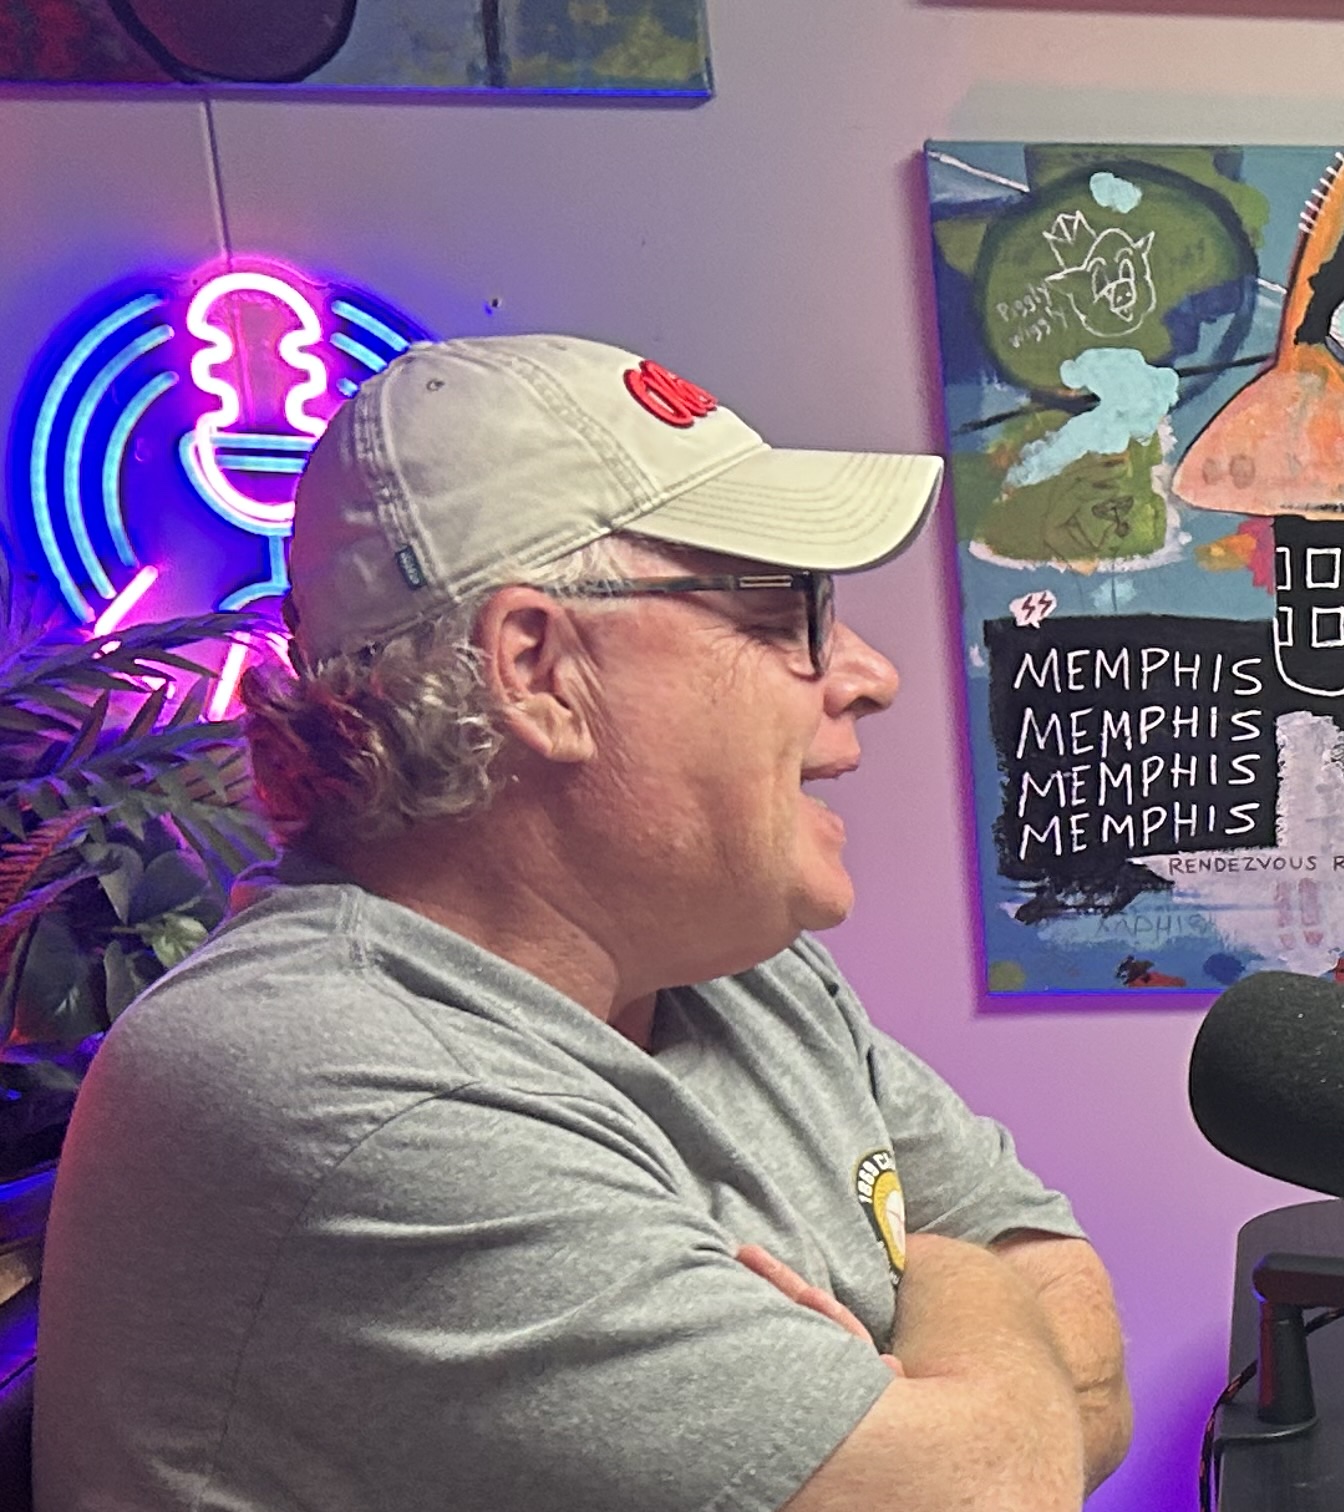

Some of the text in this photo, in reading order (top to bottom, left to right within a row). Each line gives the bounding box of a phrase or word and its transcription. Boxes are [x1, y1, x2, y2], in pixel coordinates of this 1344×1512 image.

[1013, 648, 1263, 696] MEMPHIS
[1016, 706, 1263, 759] MEMPHIS
[1018, 753, 1262, 817] MEMPHIS
[1019, 802, 1261, 861] MEMPHIS
[1168, 855, 1318, 876] RENDEZVOUS
